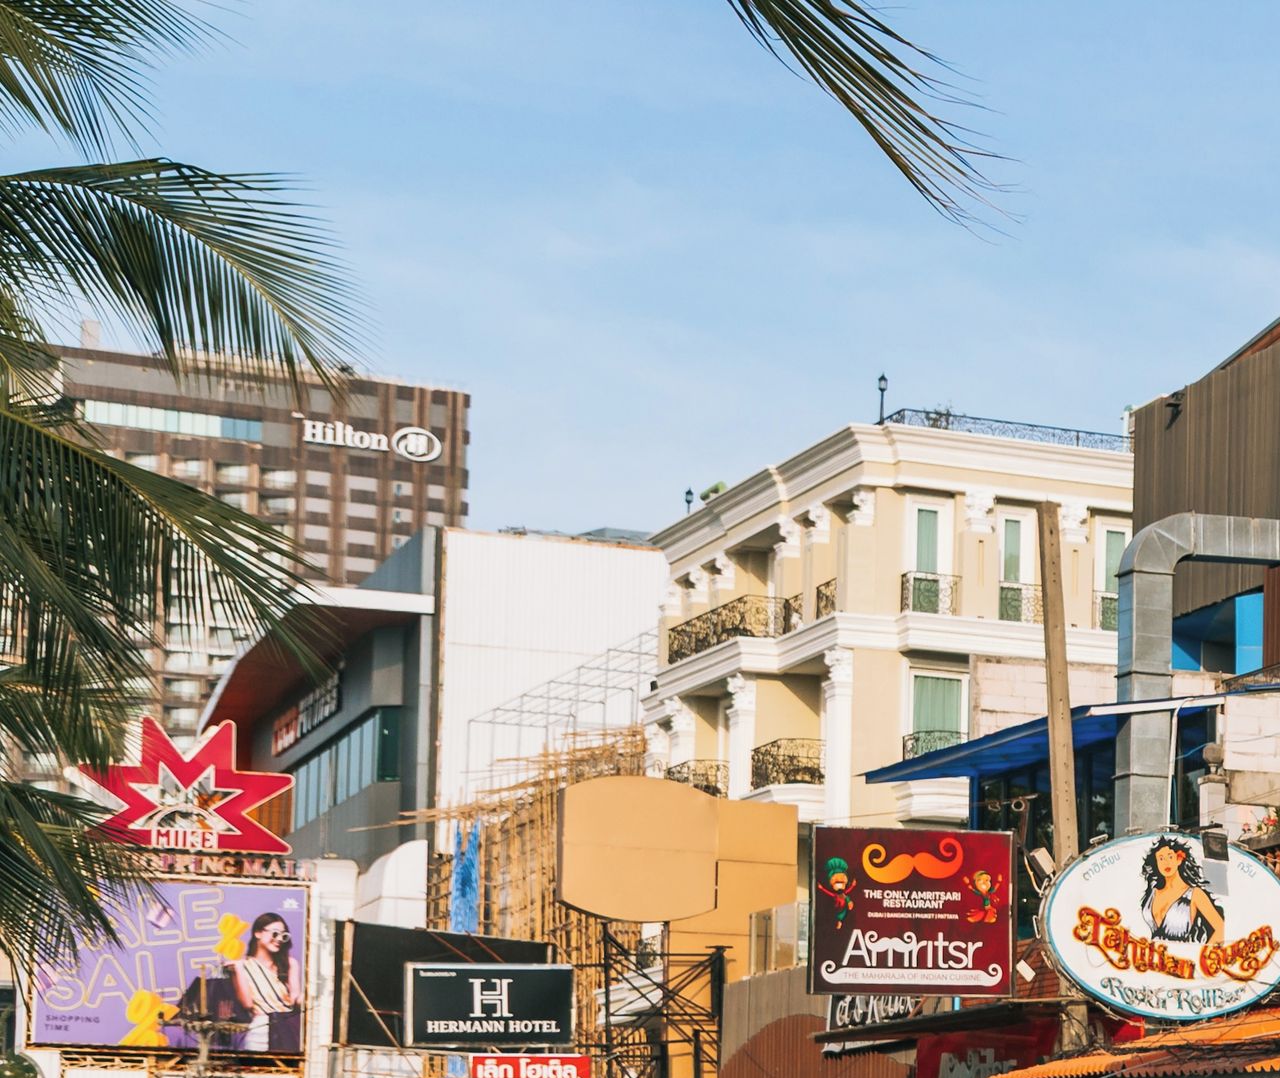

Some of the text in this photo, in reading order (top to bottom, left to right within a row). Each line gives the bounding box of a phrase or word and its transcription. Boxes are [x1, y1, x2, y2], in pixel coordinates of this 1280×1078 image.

[303, 419, 390, 451] Hilton
[155, 830, 215, 849] MIKE
[864, 889, 962, 901] THE ONLY AMRITSARI
[883, 899, 944, 909] RESTAURANT
[1072, 905, 1280, 981] Tahitian Queen
[844, 971, 857, 979] THE
[861, 972, 905, 980] MAHARAJA
[921, 973, 948, 981] INDIAN
[949, 974, 982, 982] CUISINE
[468, 978, 514, 1018] H
[45, 1014, 101, 1024] SHOPPING
[44, 1023, 70, 1032] TIME
[427, 1020, 561, 1034] HERMANN HOTEL
[476, 1058, 514, 1078] เล็ก
